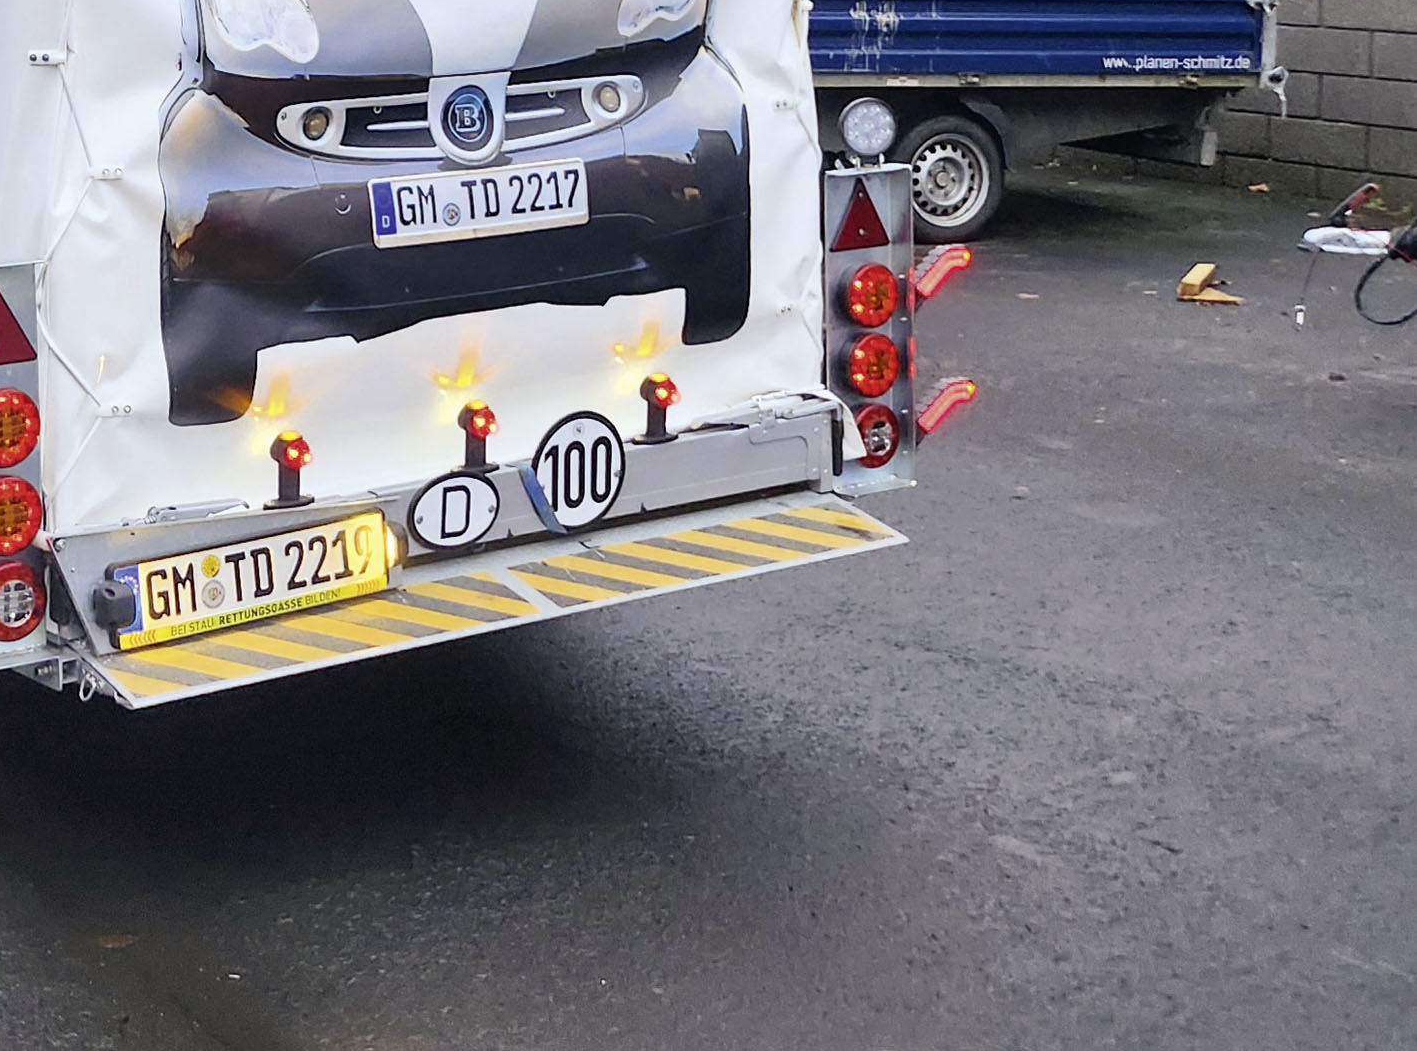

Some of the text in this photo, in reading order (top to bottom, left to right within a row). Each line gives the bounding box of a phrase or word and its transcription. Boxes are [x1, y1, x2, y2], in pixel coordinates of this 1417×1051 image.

[455, 104, 481, 133] B
[382, 215, 390, 228] D
[396, 168, 580, 226] GM TD 2217
[544, 435, 612, 512] 100
[440, 484, 471, 539] D
[145, 524, 374, 620] GM TD 2219
